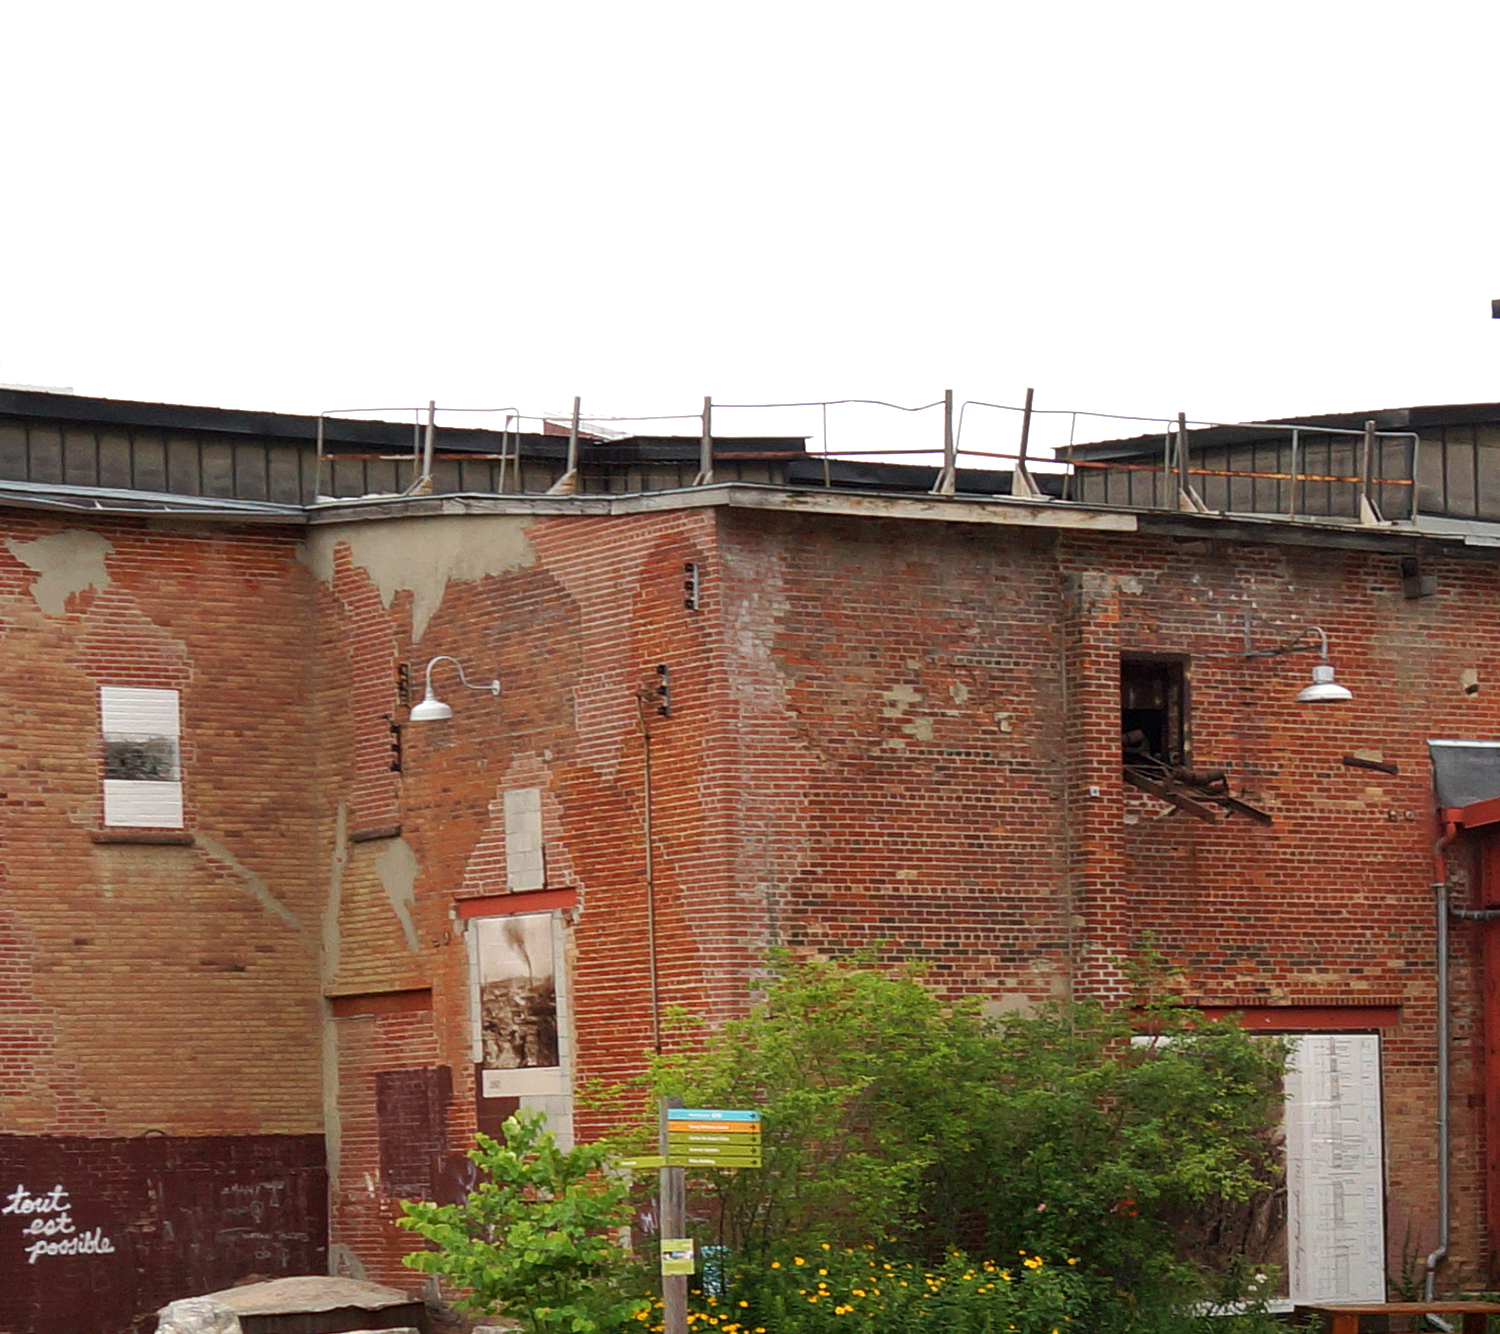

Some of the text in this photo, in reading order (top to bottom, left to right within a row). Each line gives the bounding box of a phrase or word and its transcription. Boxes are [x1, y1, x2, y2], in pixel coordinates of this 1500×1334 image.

[1, 1184, 71, 1214] tout
[22, 1212, 76, 1236] est
[24, 1227, 116, 1264] possible
